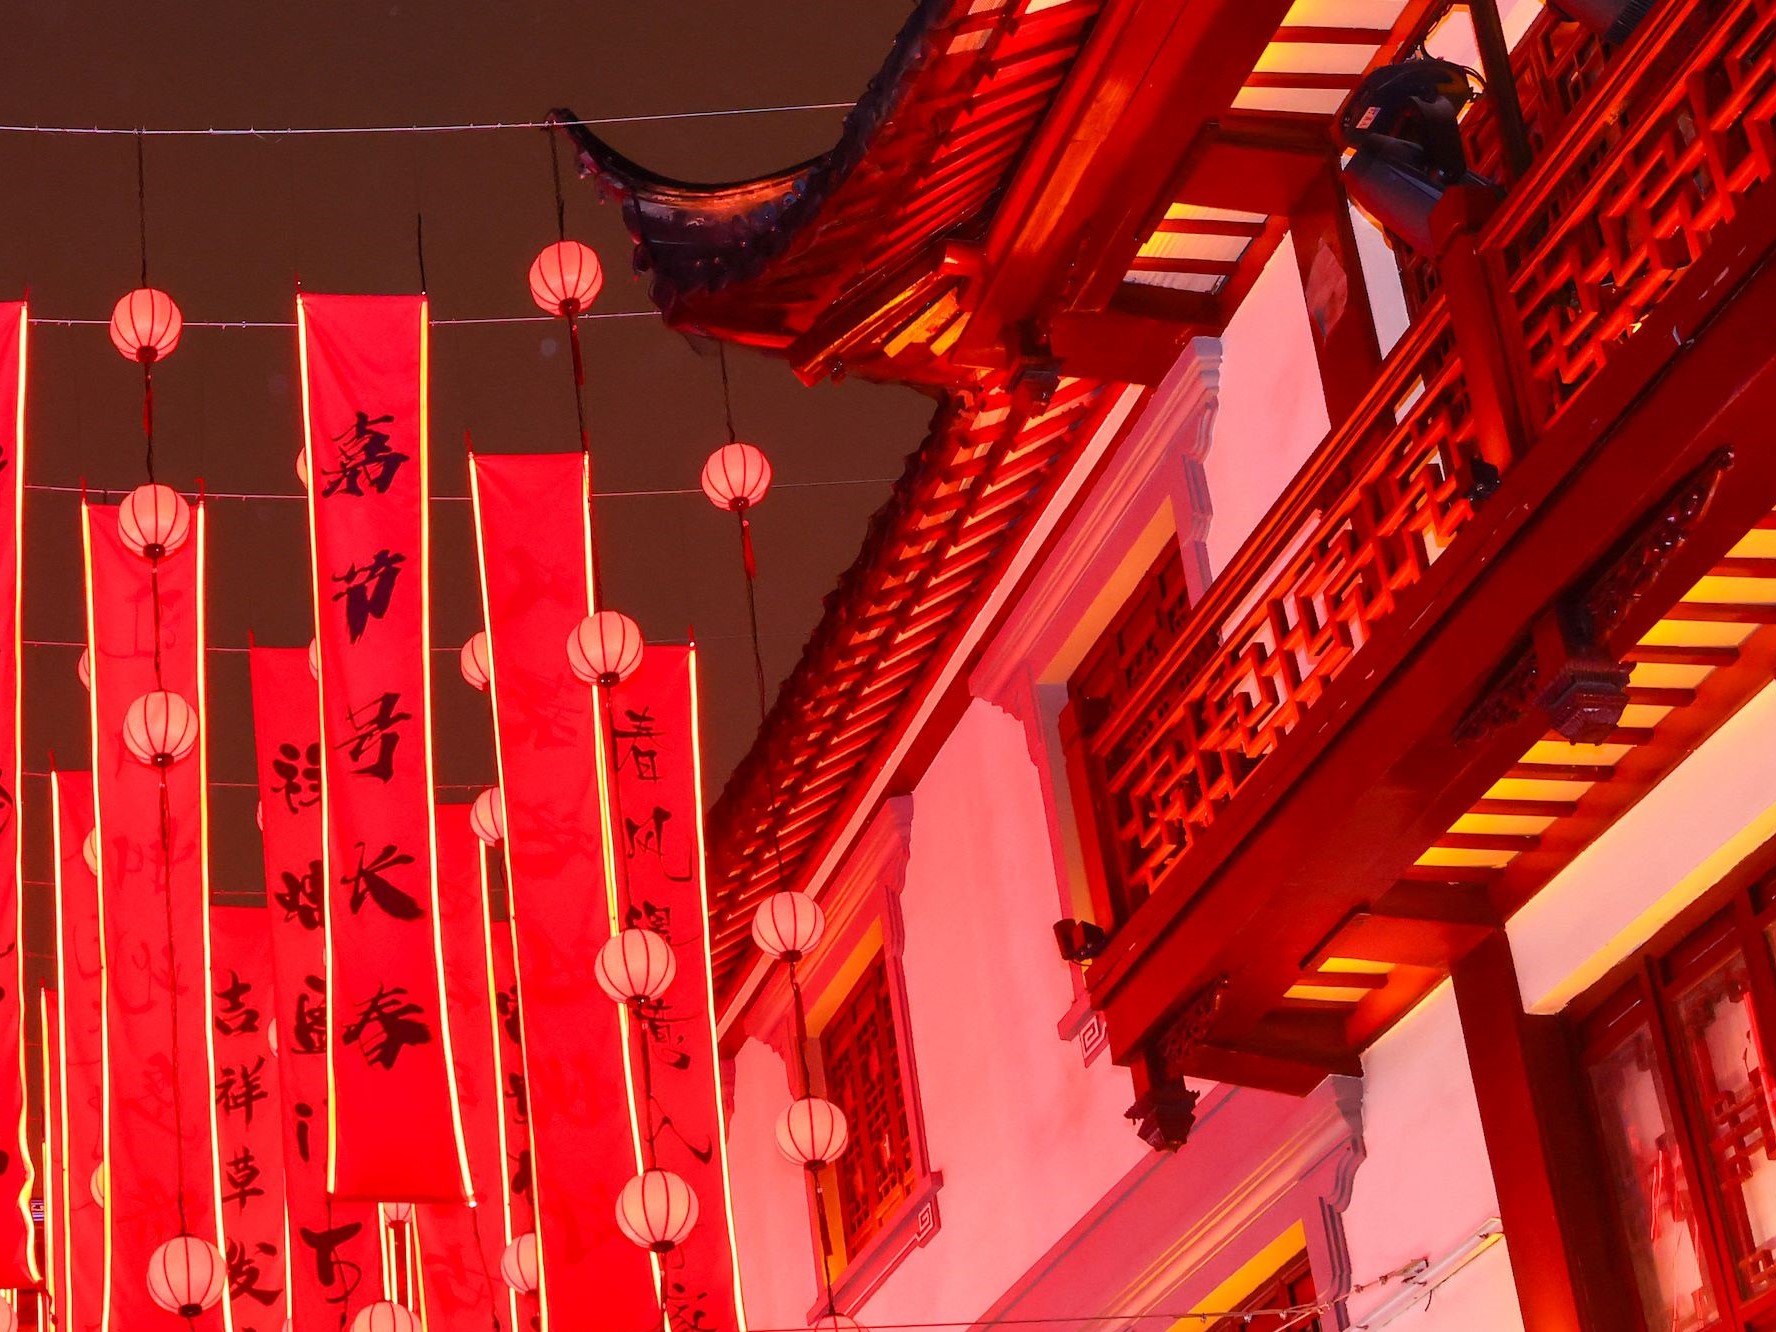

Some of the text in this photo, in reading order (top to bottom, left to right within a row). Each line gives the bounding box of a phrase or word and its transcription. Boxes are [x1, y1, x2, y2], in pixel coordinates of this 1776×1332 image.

[321, 411, 432, 1070] 嘉节号长春
